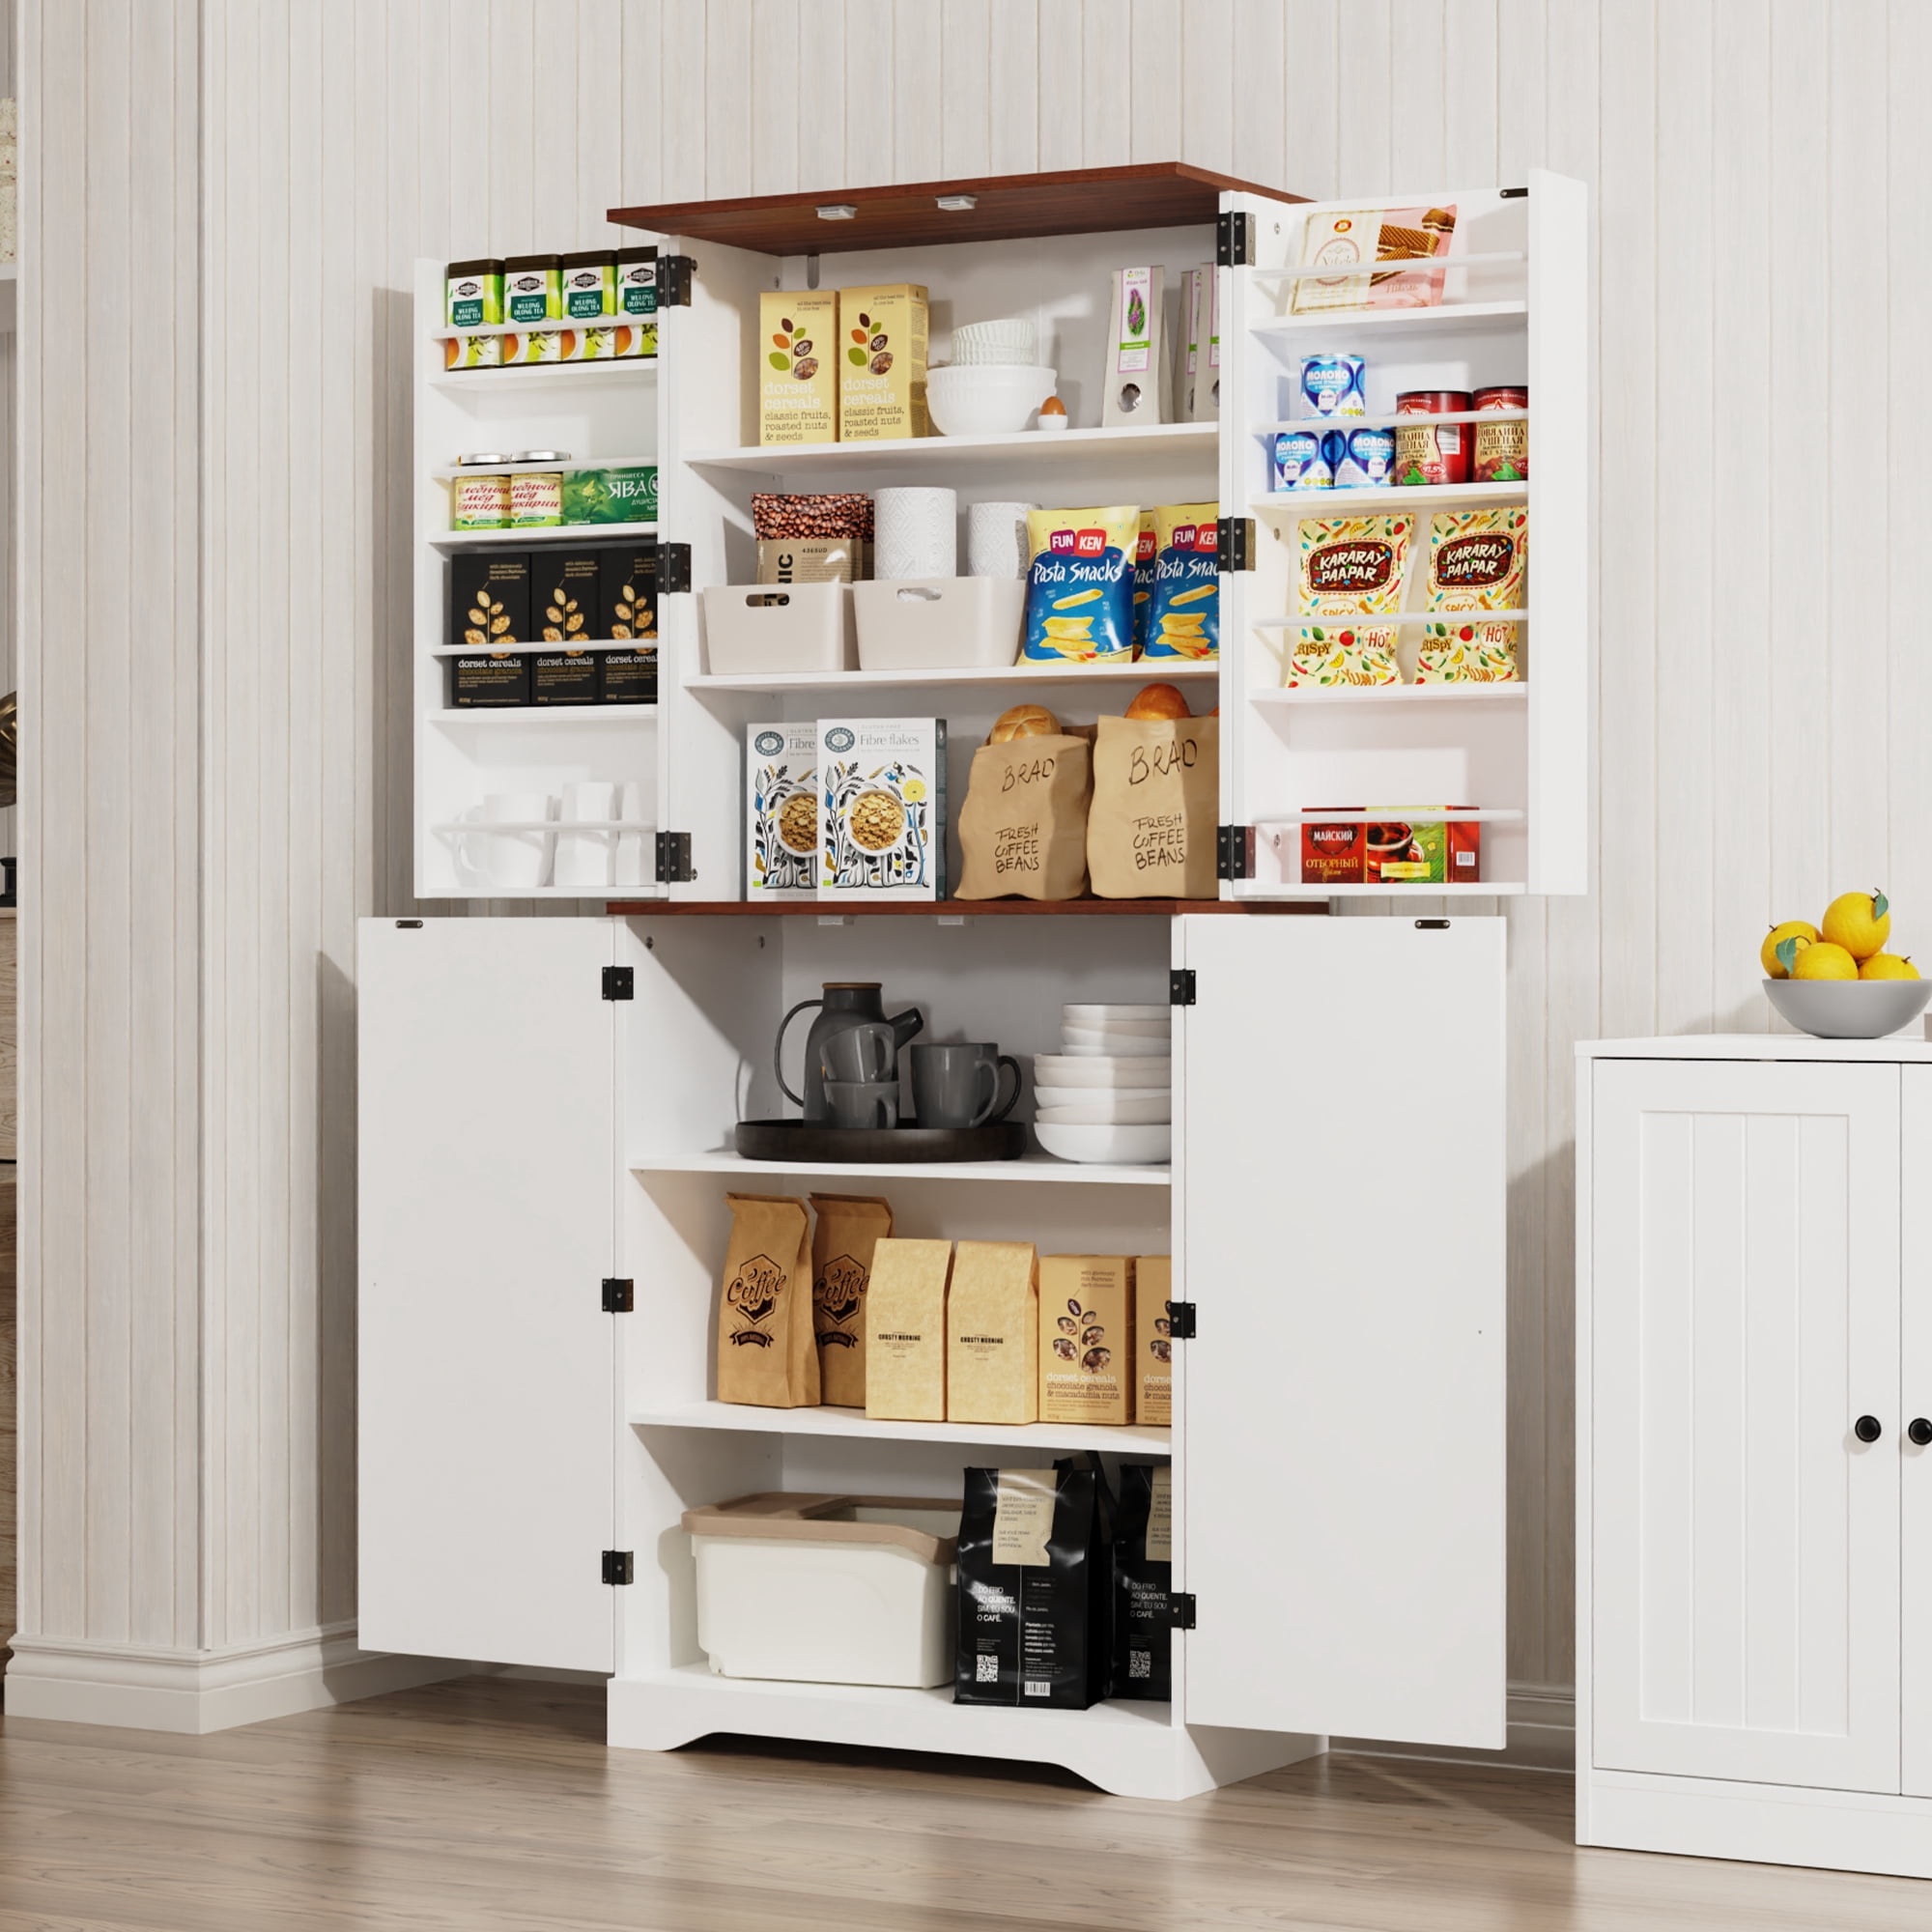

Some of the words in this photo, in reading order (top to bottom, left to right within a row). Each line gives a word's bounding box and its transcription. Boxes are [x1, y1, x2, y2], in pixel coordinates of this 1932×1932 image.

[1307, 370, 1350, 382] МОЛОКО
[764, 382, 814, 395] dorset
[843, 378, 890, 391] dorset
[764, 396, 820, 411] cereals
[843, 391, 895, 407] cereals
[765, 412, 798, 421] classic
[801, 412, 831, 421] fruits,
[844, 409, 874, 417] classic
[876, 407, 905, 415] fruits,
[765, 422, 802, 432] roasted
[844, 418, 878, 427] roasted
[881, 416, 901, 425] nuts
[855, 428, 879, 437] seeds
[608, 480, 648, 499] ЯВА
[1052, 534, 1074, 549] FUN
[1079, 536, 1102, 551] KEN
[1175, 529, 1195, 544] FUN
[1321, 550, 1385, 570] KARARAY
[1446, 544, 1507, 564] KARARAY
[1034, 561, 1065, 584] Pasta
[1068, 558, 1122, 583] Snacks
[1156, 557, 1184, 580] Pasta
[1321, 565, 1378, 583] PAAPAR
[1446, 560, 1497, 579] PAAPAR
[1293, 642, 1332, 657] RISPY
[1420, 639, 1453, 653] RISPY
[459, 659, 488, 668] dorset
[489, 658, 522, 668] cereals
[537, 658, 564, 667] dorset
[564, 657, 594, 666] cereals
[606, 655, 633, 665] dorset
[634, 655, 658, 664] cereal
[789, 738, 815, 750] Fibre
[860, 733, 887, 745] Fibre
[890, 733, 920, 745] flakes
[1133, 813, 1182, 831] FRESH
[996, 823, 1038, 842] FRESH
[1133, 829, 1184, 849] COFFEE
[1314, 830, 1352, 841] МАЙСКИЙ
[995, 839, 1038, 858] COFFEE
[996, 857, 1039, 874] BEANS
[1135, 847, 1185, 870] BEANS
[1306, 857, 1358, 868] ОТБОРНЫЙ
[727, 1272, 786, 1303] Coffee
[813, 1272, 869, 1303] Coffee
[1046, 1372, 1078, 1382] dorset
[1081, 1373, 1116, 1383] cereals
[1144, 1374, 1172, 1383] dorse
[1087, 1383, 1118, 1392] granola
